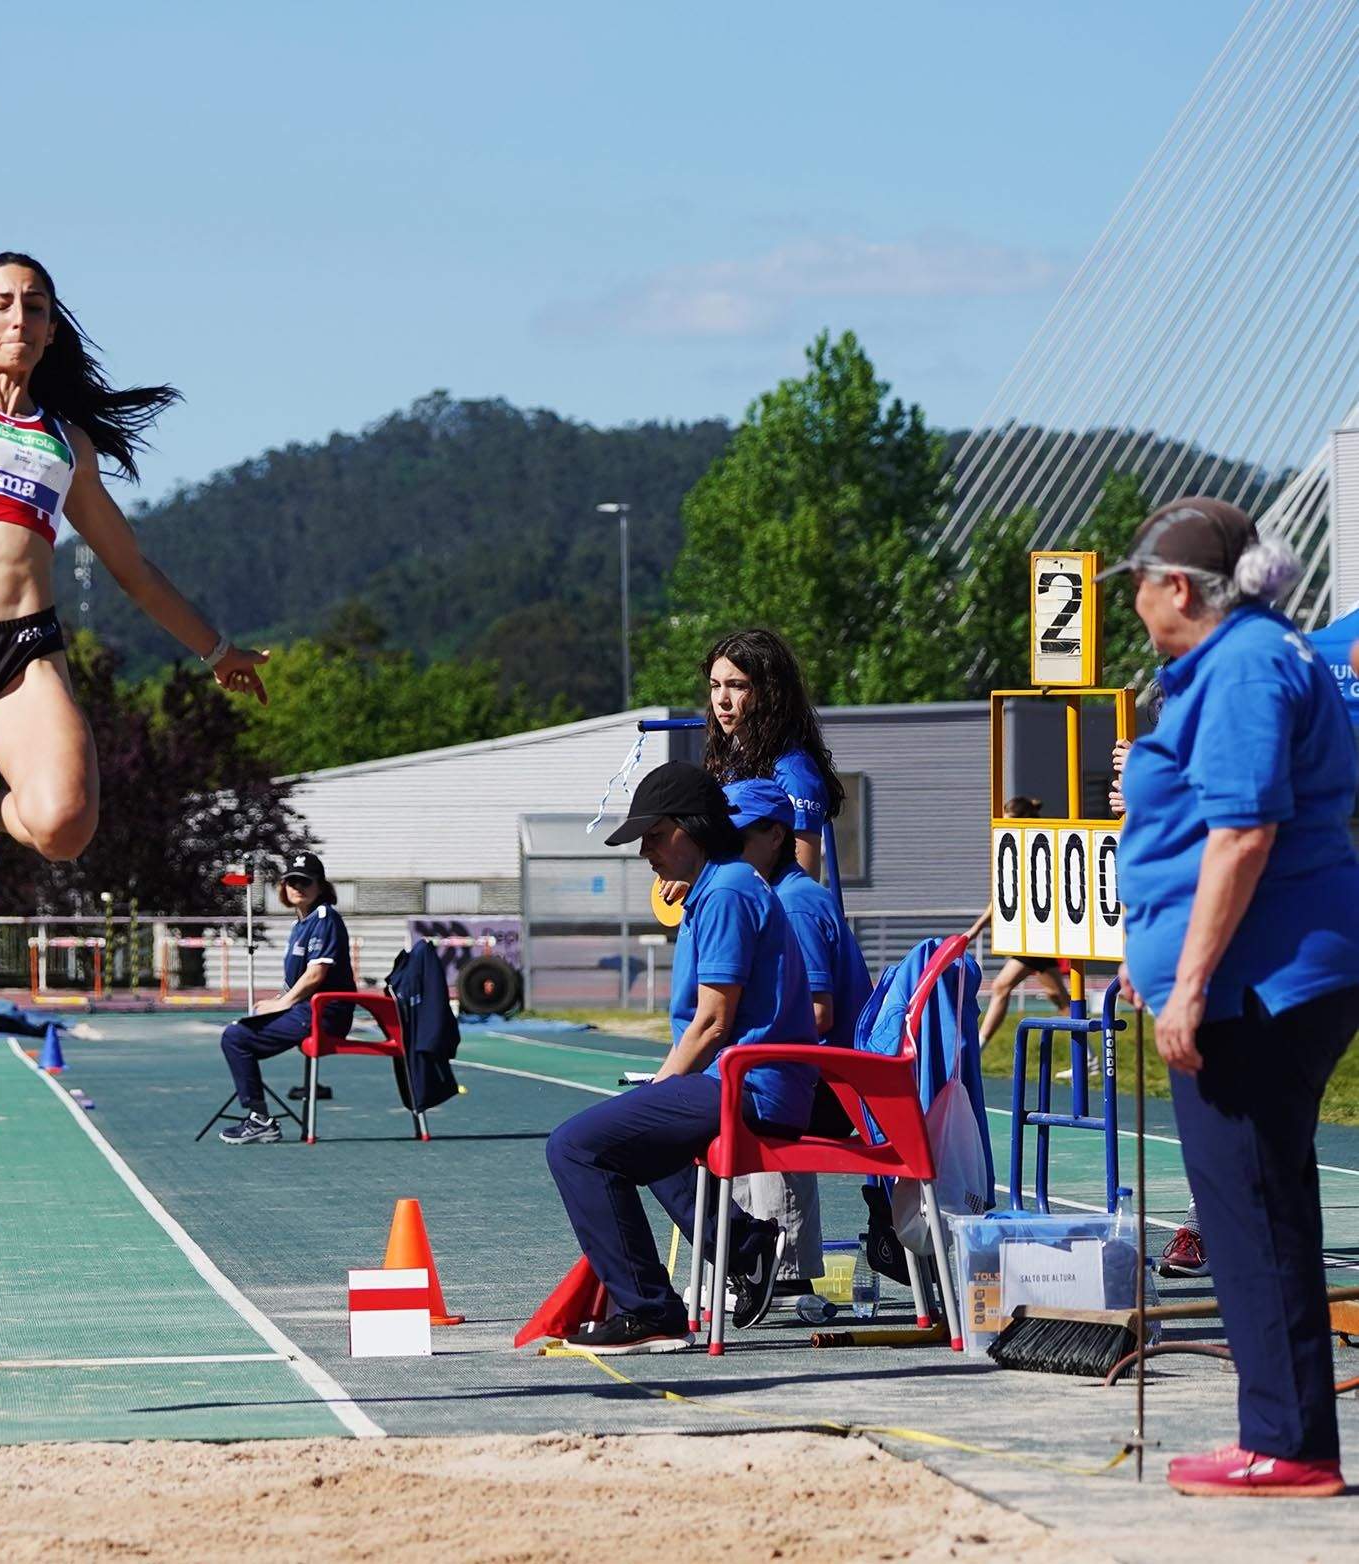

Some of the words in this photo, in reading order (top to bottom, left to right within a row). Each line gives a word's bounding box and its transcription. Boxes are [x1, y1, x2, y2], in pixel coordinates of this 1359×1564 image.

[1037, 572, 1082, 655] 2
[1020, 1275, 1041, 1284] SALTO
[1051, 1273, 1077, 1282] ALTURA
